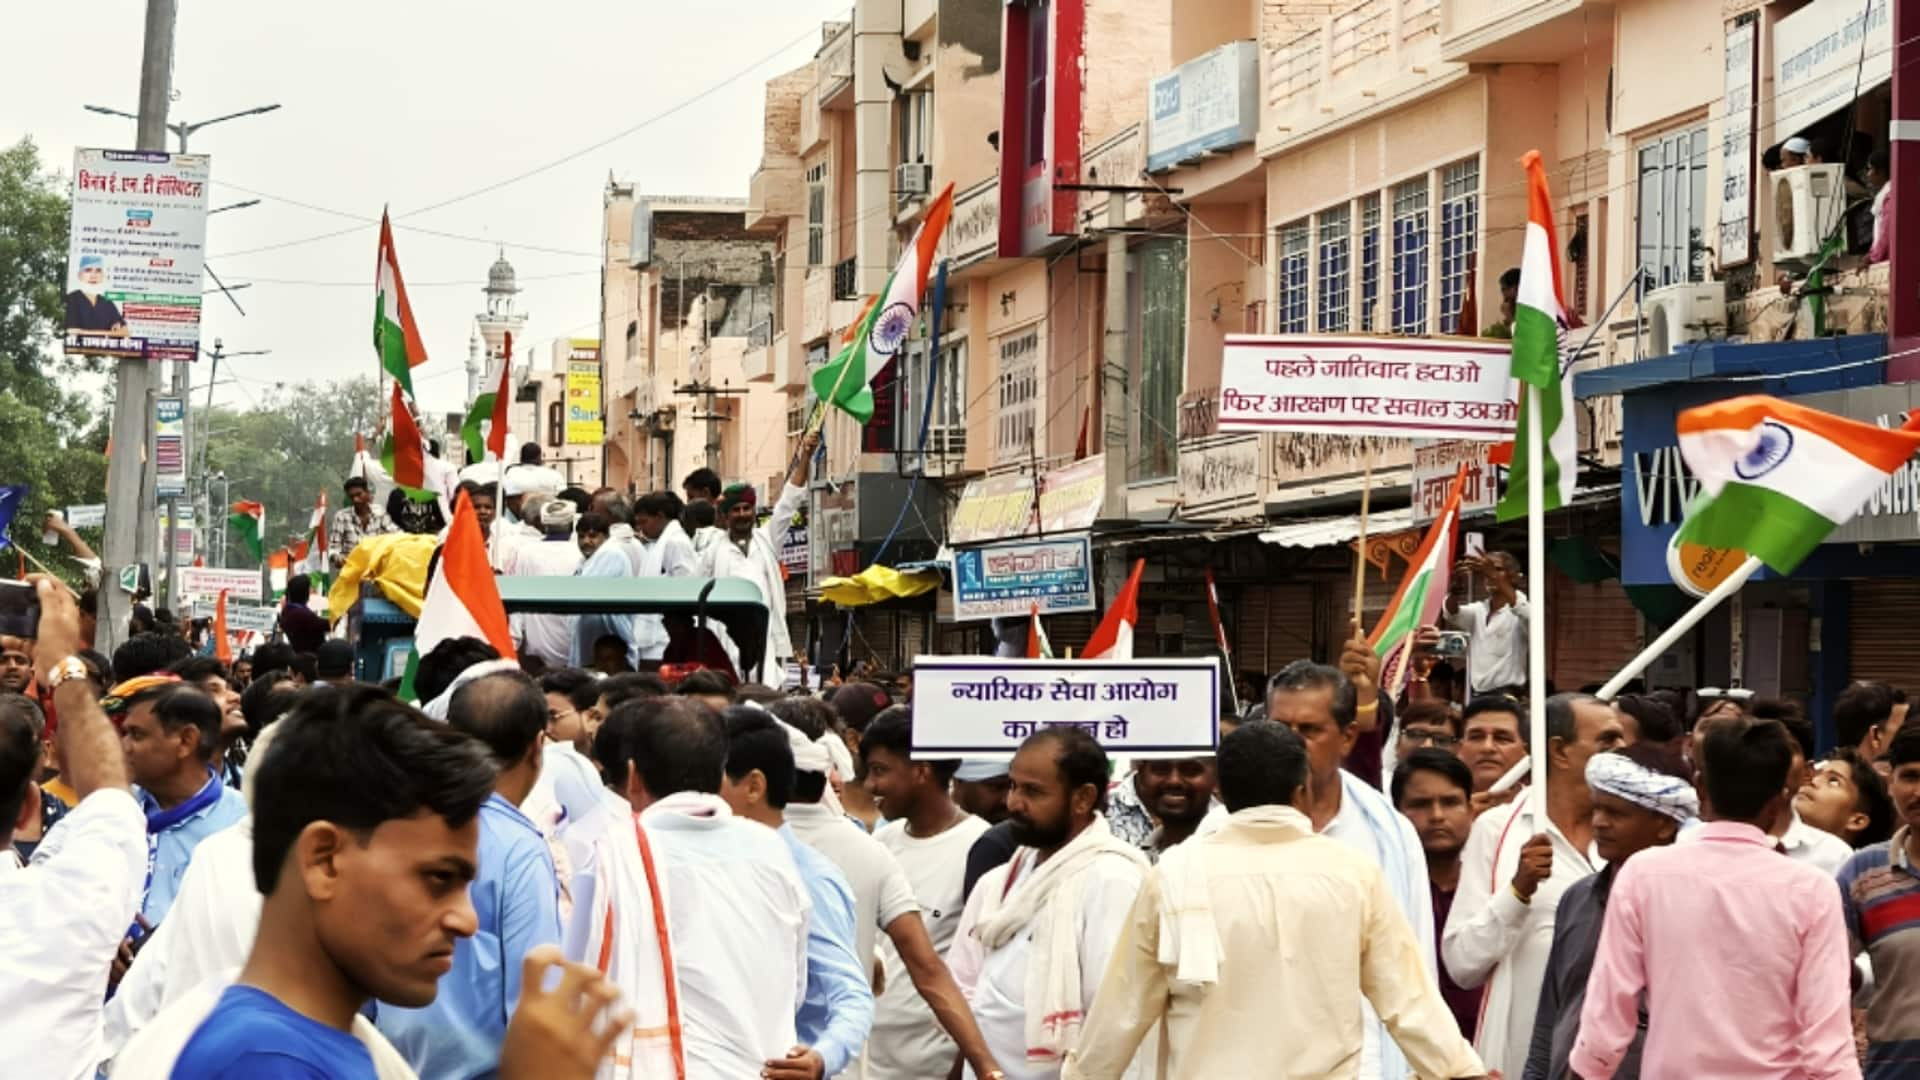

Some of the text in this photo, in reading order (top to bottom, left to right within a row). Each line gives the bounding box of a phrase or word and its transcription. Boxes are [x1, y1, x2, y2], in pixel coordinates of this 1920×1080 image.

[1265, 353, 1481, 384] पहले जातिवाद हटाओ
[1222, 387, 1519, 422] फिर आरक्षण पर सवाल उठाओ
[1633, 445, 1702, 526] VIV
[951, 675, 1178, 701] न्यायिक सेवा आयोग
[1002, 720, 1037, 739] का
[1104, 714, 1128, 739] हो
